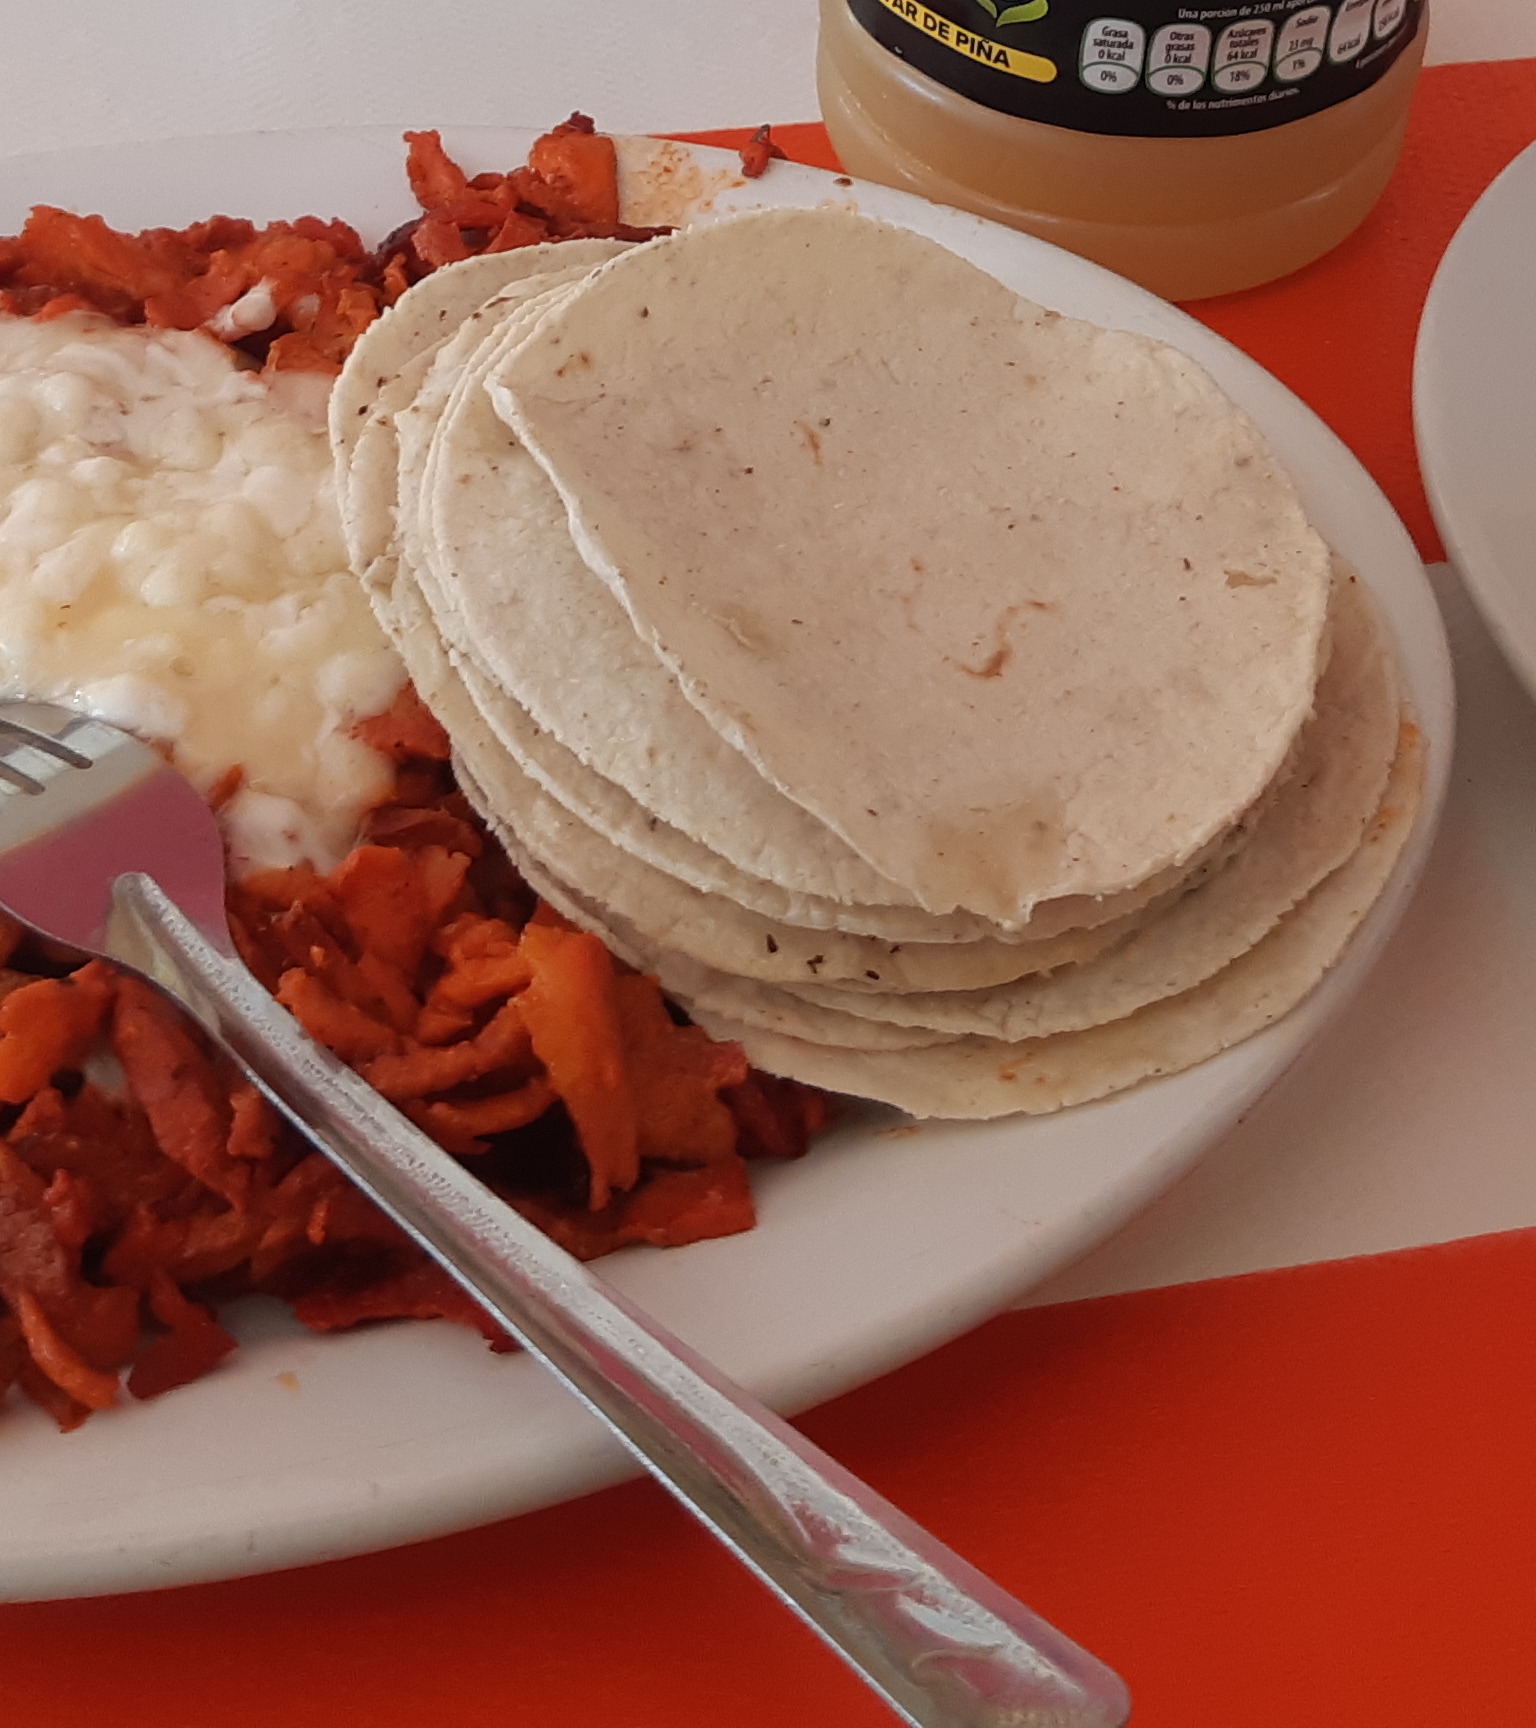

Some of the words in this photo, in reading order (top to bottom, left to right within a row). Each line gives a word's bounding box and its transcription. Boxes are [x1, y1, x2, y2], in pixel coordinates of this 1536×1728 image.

[1177, 7, 1199, 19] Una
[1239, 4, 1253, 17] de
[1101, 25, 1129, 39] Grasa
[1169, 31, 1195, 42] Otras
[923, 12, 950, 41] DE
[955, 29, 1012, 69] PIÑA
[1165, 43, 1196, 55] grasas
[1100, 70, 1118, 83] 0%
[1166, 74, 1184, 86] 0%
